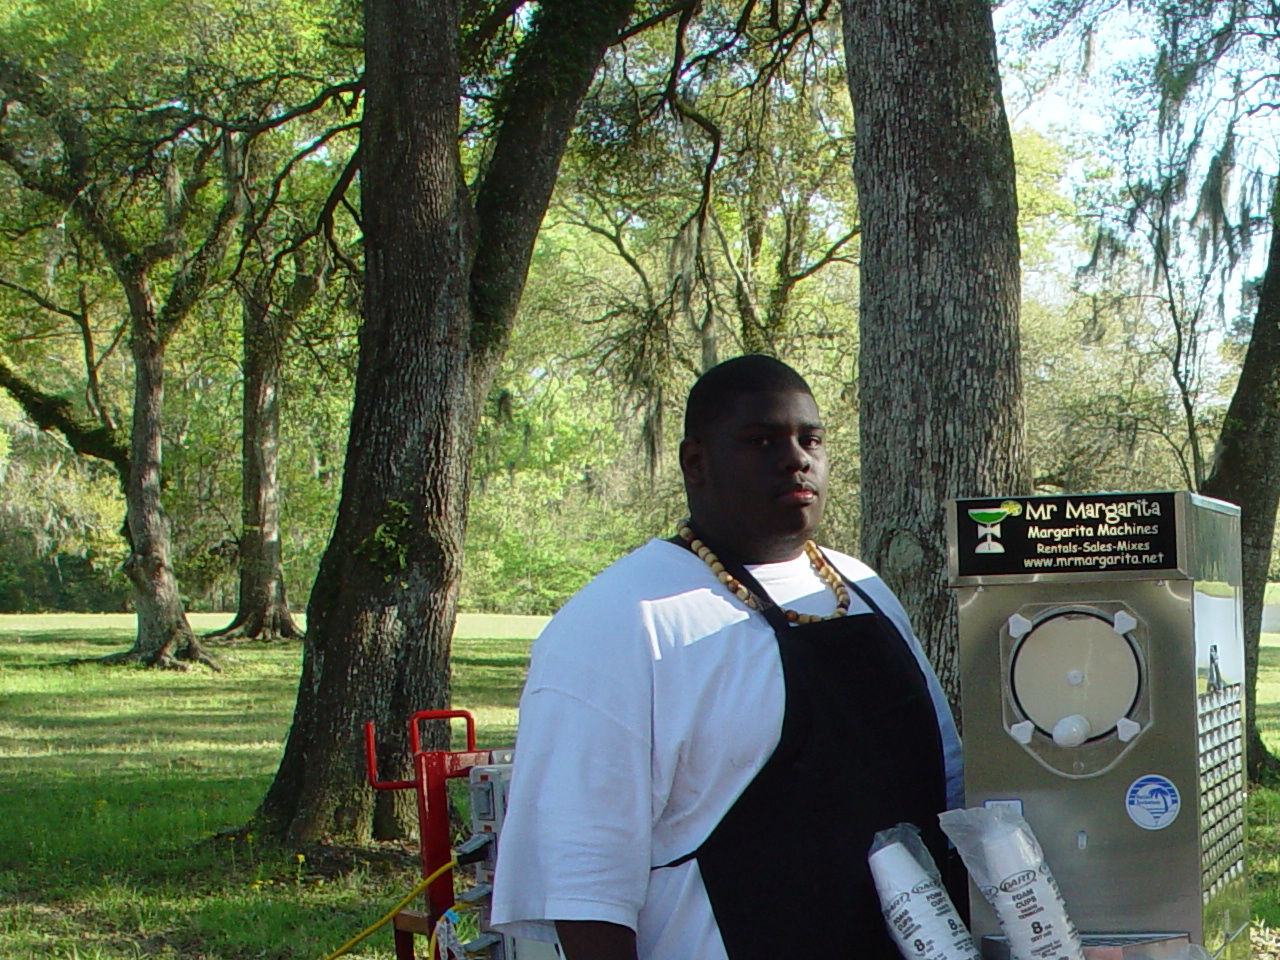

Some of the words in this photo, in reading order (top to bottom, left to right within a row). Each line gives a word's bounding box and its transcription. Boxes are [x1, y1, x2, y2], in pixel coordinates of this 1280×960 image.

[1025, 501, 1057, 520] Mr
[1065, 499, 1161, 524] Margarita
[1027, 525, 1094, 541] Margarita
[1097, 522, 1159, 537] Machines
[1024, 552, 1165, 570] www.mrmargarita.net
[1011, 888, 1034, 901] FOAM
[1031, 921, 1043, 934] 8
[914, 938, 925, 951] 8
